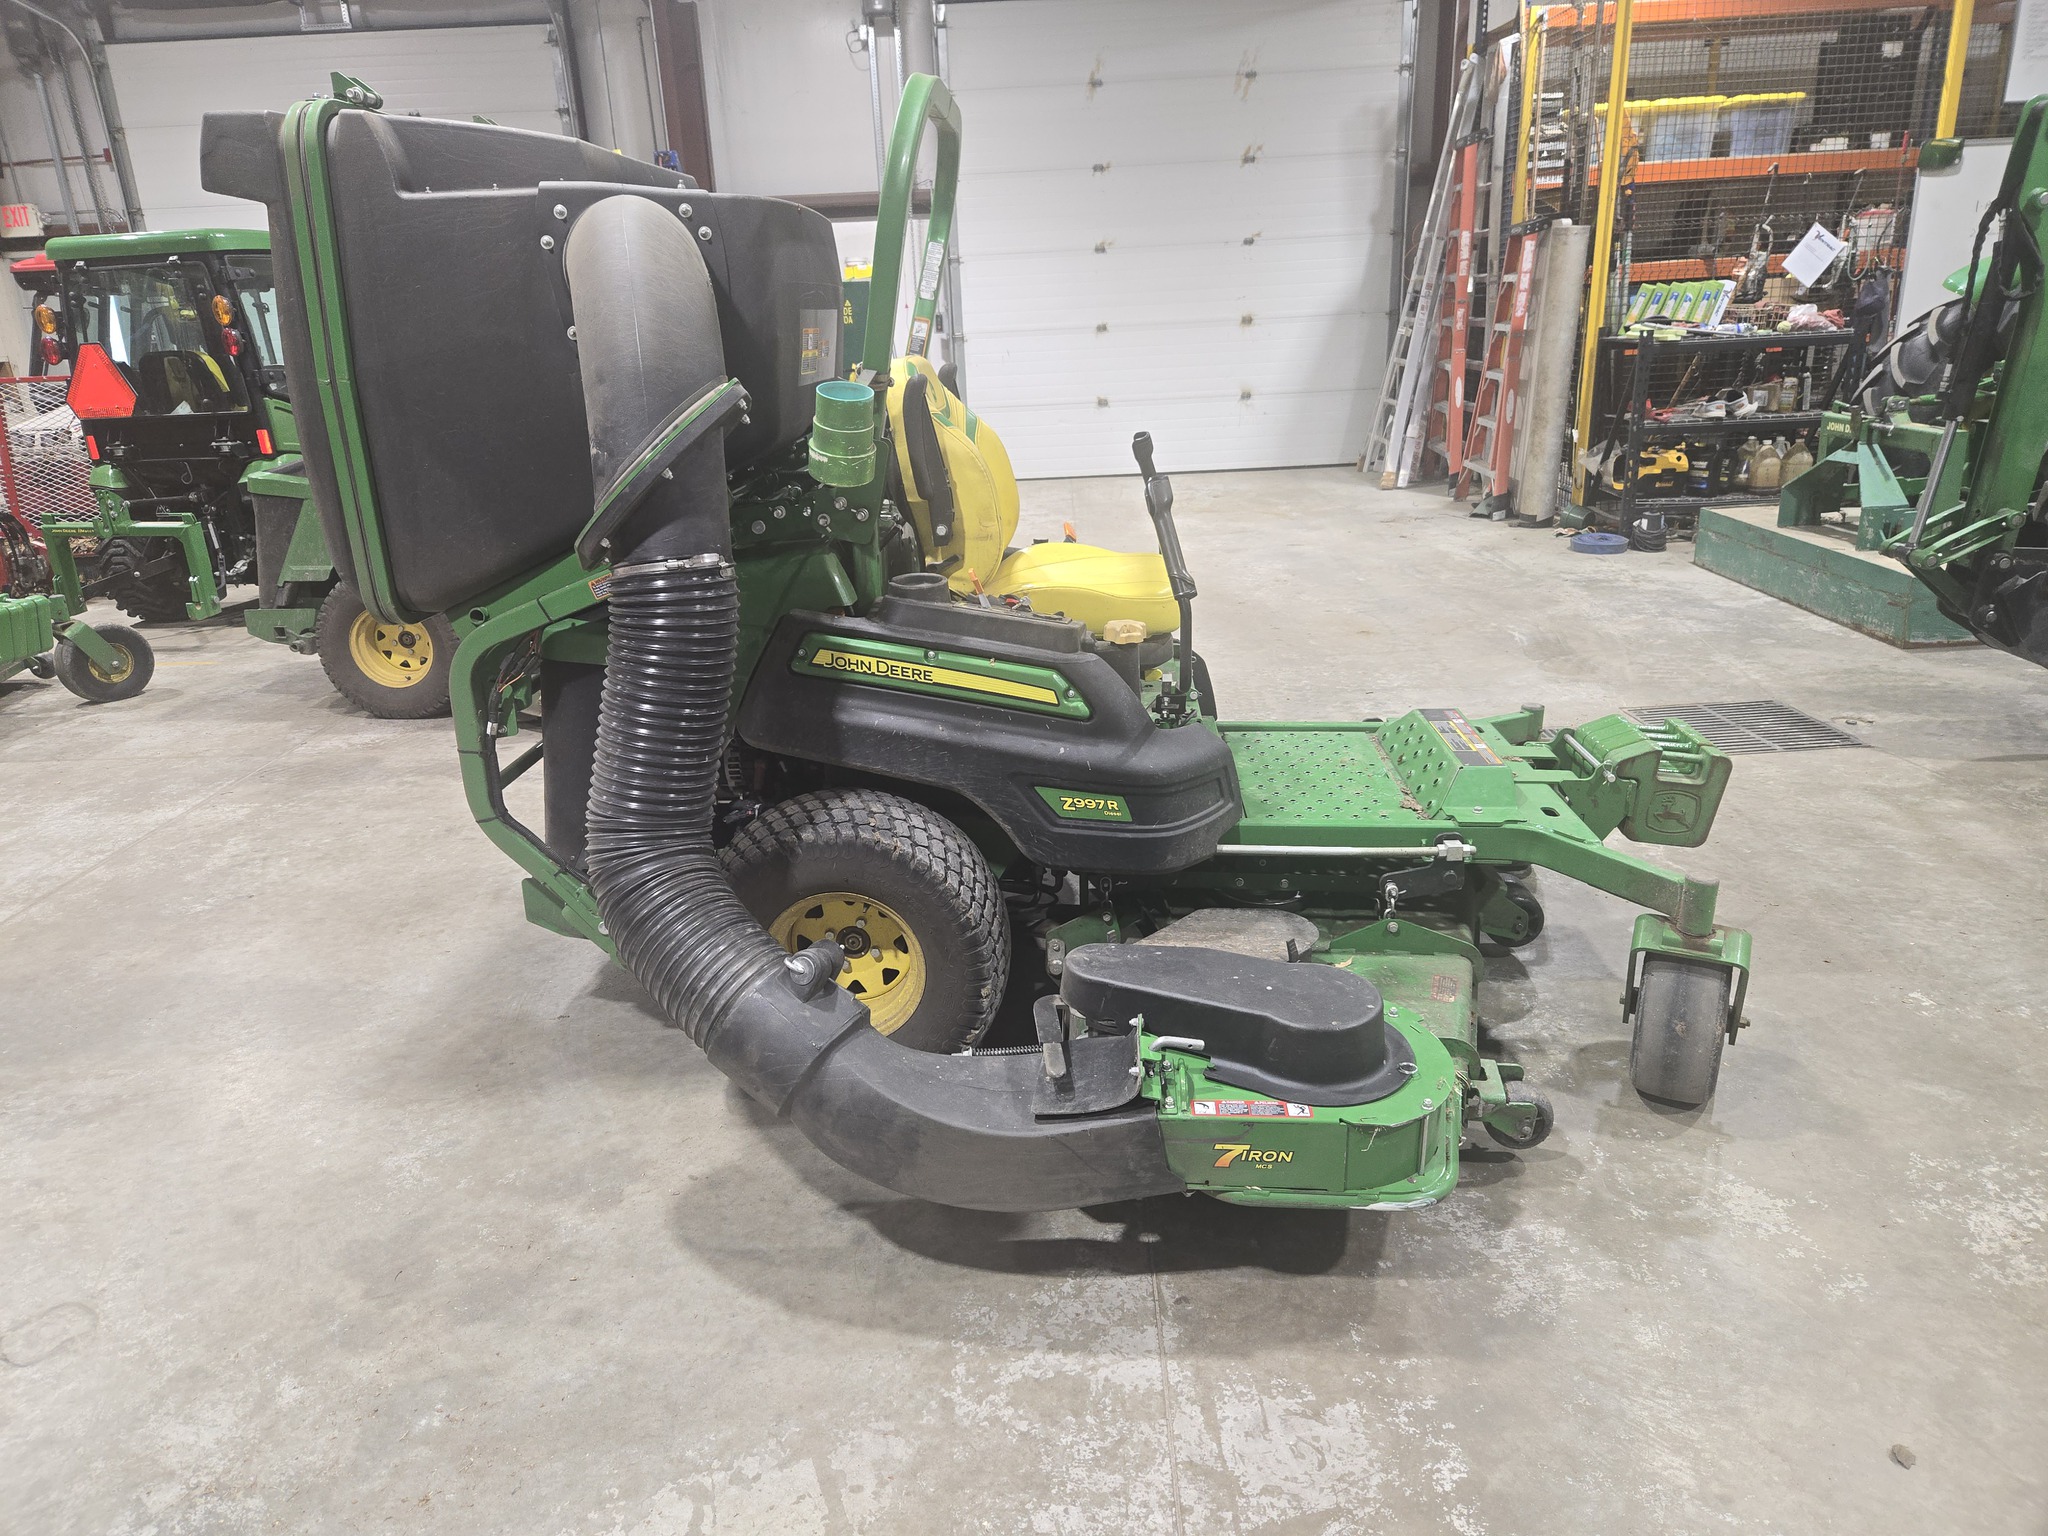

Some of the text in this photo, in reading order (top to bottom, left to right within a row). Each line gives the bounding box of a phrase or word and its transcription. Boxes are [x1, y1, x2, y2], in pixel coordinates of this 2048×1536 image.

[2, 206, 29, 228] EXIT
[1827, 422, 1844, 432] JOHN
[825, 653, 933, 681] JOHN DEERE
[1060, 797, 1119, 811] Z997R
